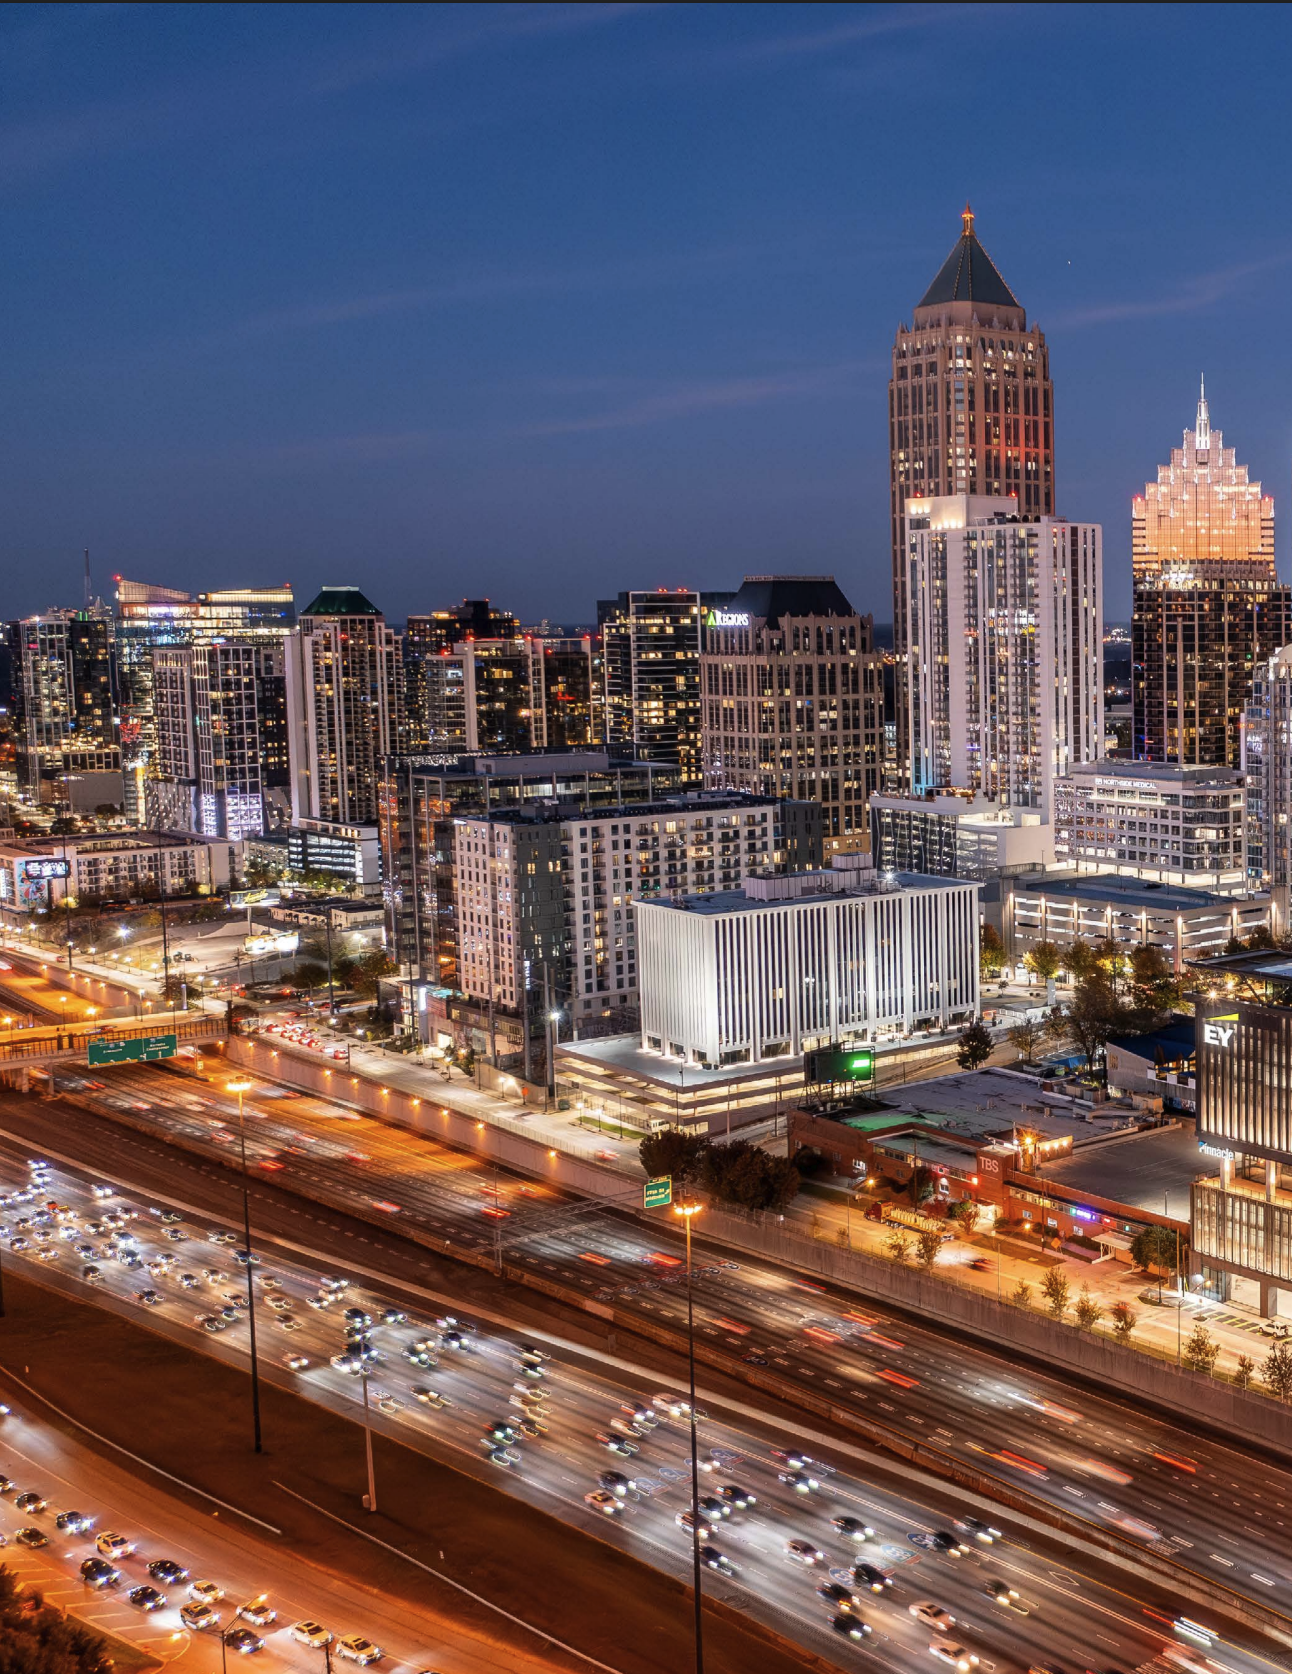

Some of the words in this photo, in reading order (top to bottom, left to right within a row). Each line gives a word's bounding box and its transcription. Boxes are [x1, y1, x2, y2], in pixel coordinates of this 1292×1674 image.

[1103, 778, 1132, 787] NORTHSIDE
[1133, 781, 1157, 789] MEDICAL
[1204, 1023, 1234, 1048] EY
[1198, 1141, 1234, 1160] Pinnacle
[979, 1156, 999, 1173] TBS
